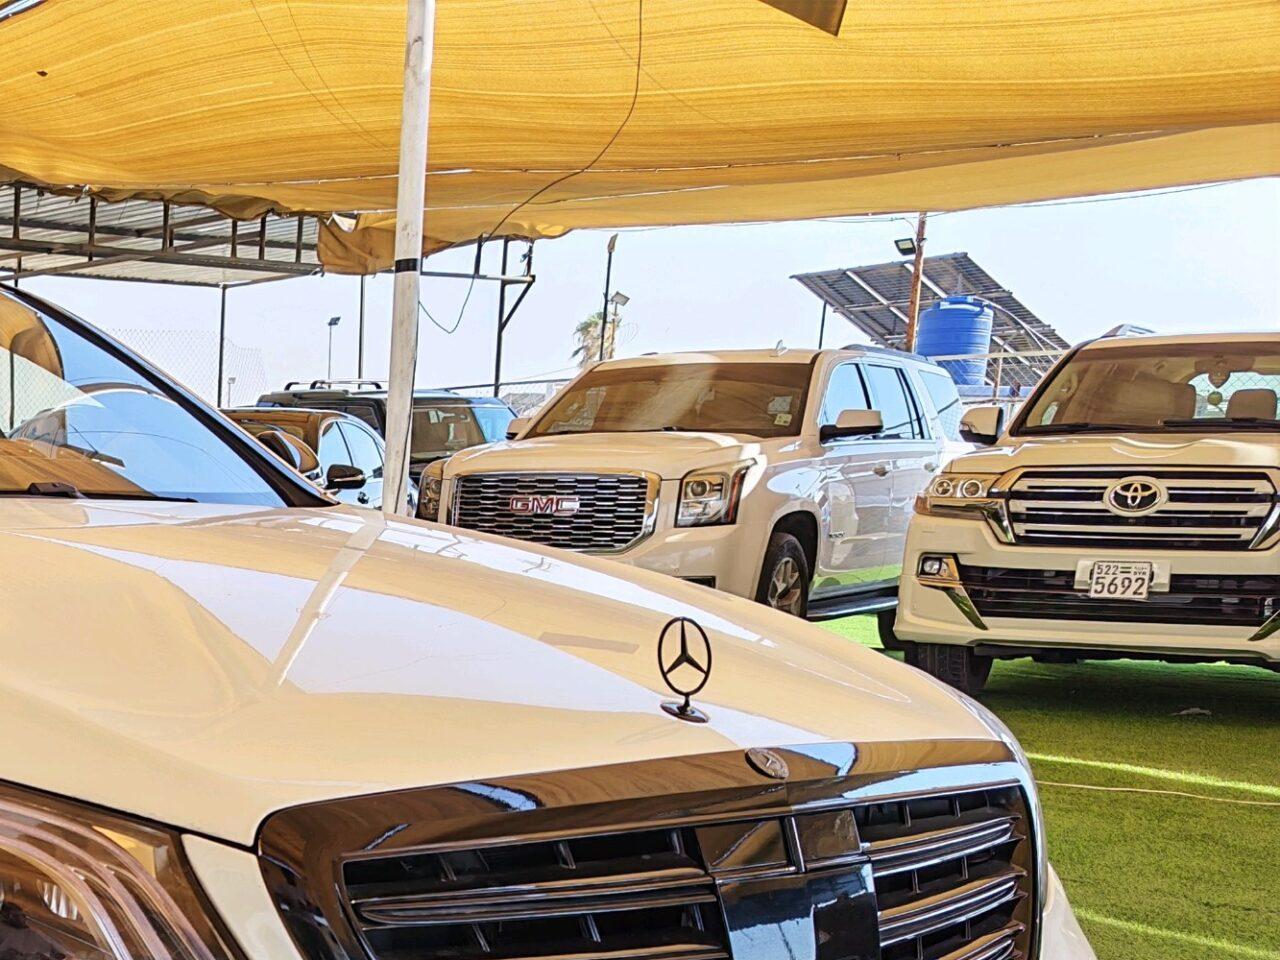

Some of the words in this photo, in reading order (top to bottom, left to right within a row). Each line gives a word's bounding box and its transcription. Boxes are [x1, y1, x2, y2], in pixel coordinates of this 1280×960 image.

[509, 495, 580, 515] GMC
[1096, 564, 1119, 576] 522
[1093, 576, 1146, 596] 5692
